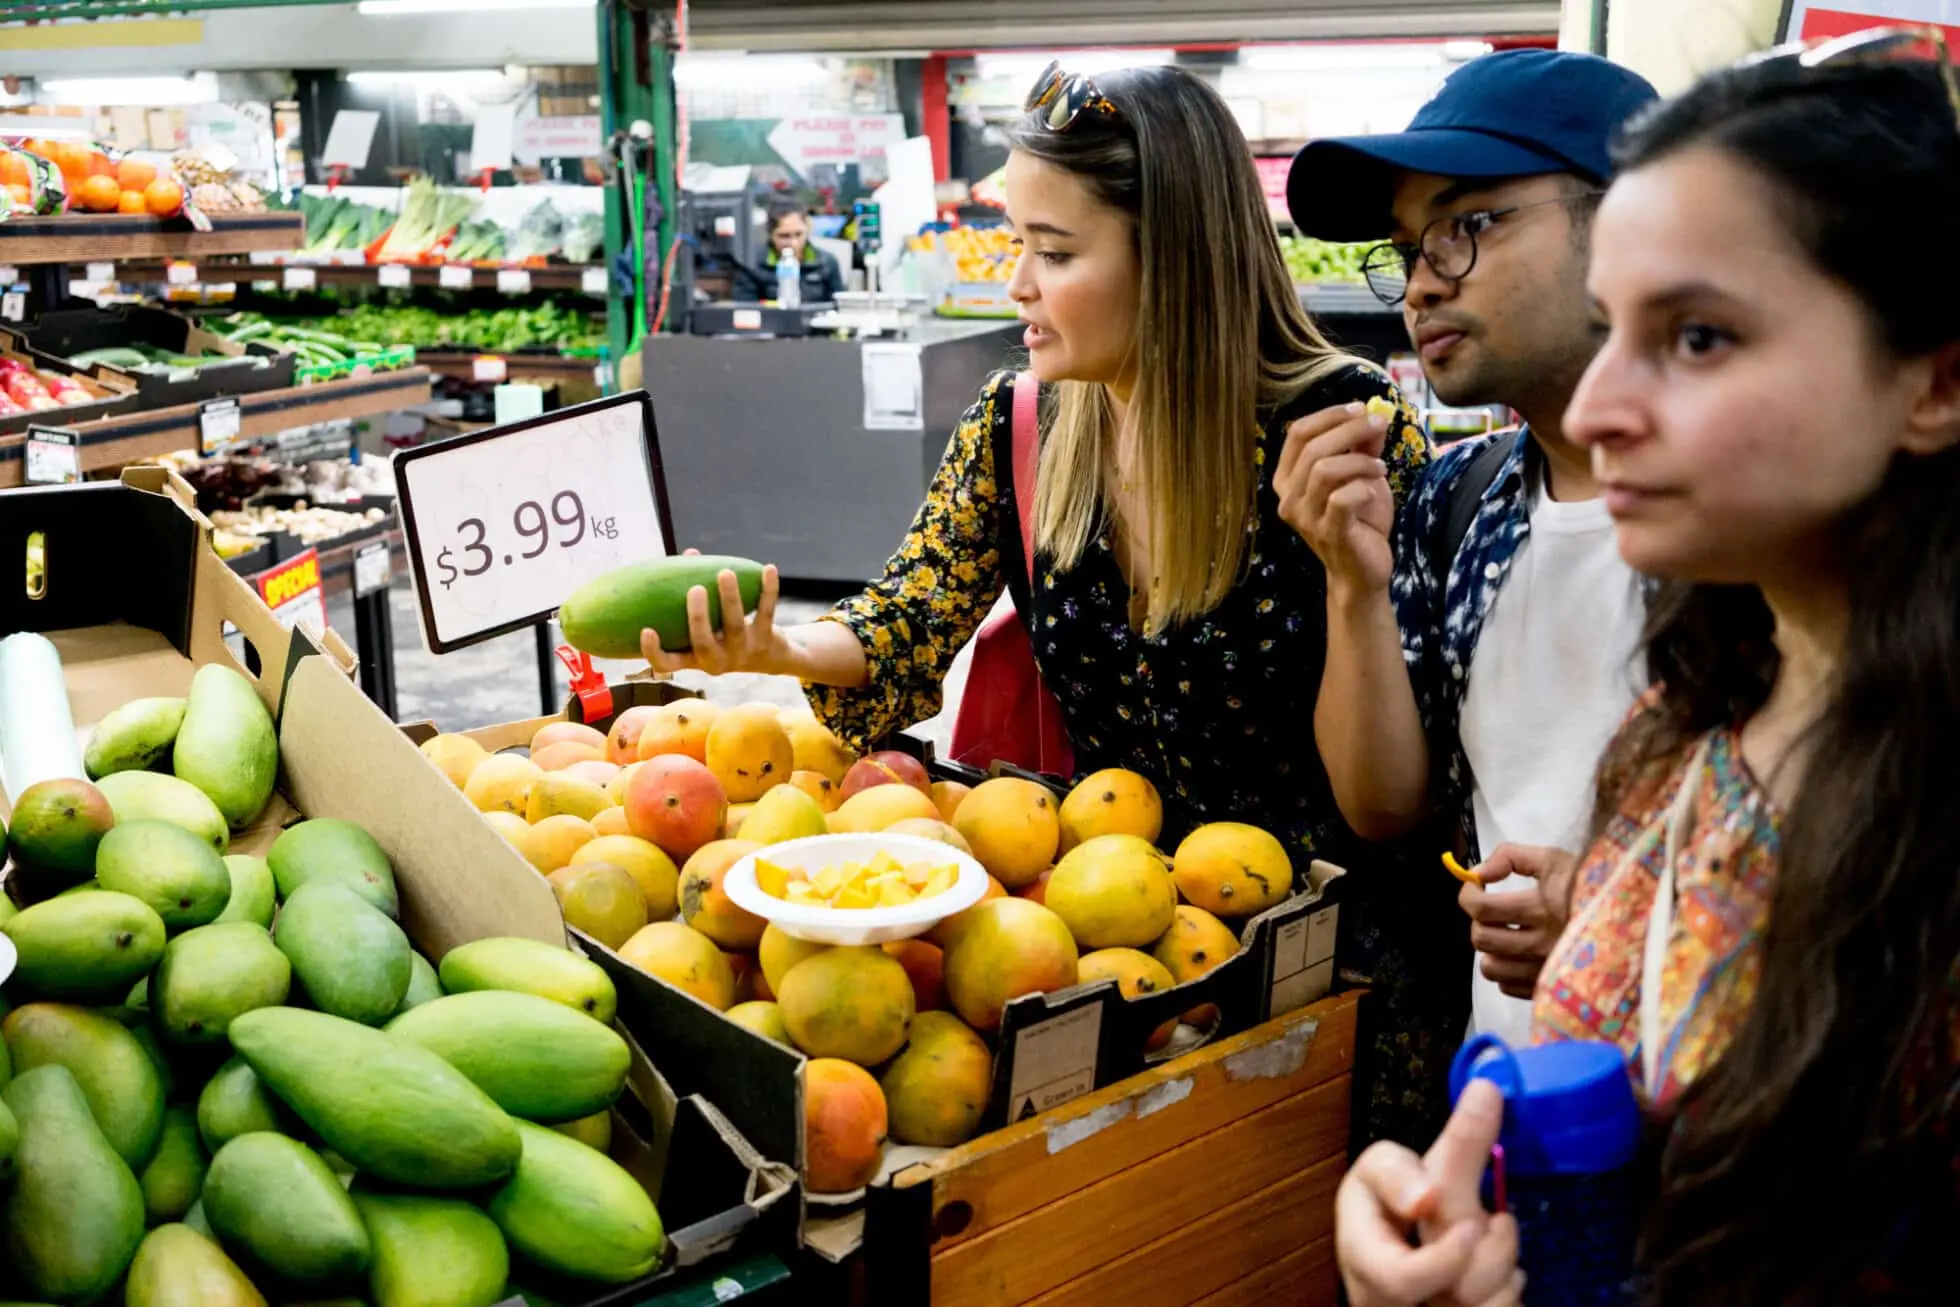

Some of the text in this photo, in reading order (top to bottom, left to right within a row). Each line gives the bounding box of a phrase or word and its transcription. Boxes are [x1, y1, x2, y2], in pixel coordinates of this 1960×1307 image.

[436, 490, 619, 590] $3.99 kg
[265, 559, 319, 609] SPECIAL
